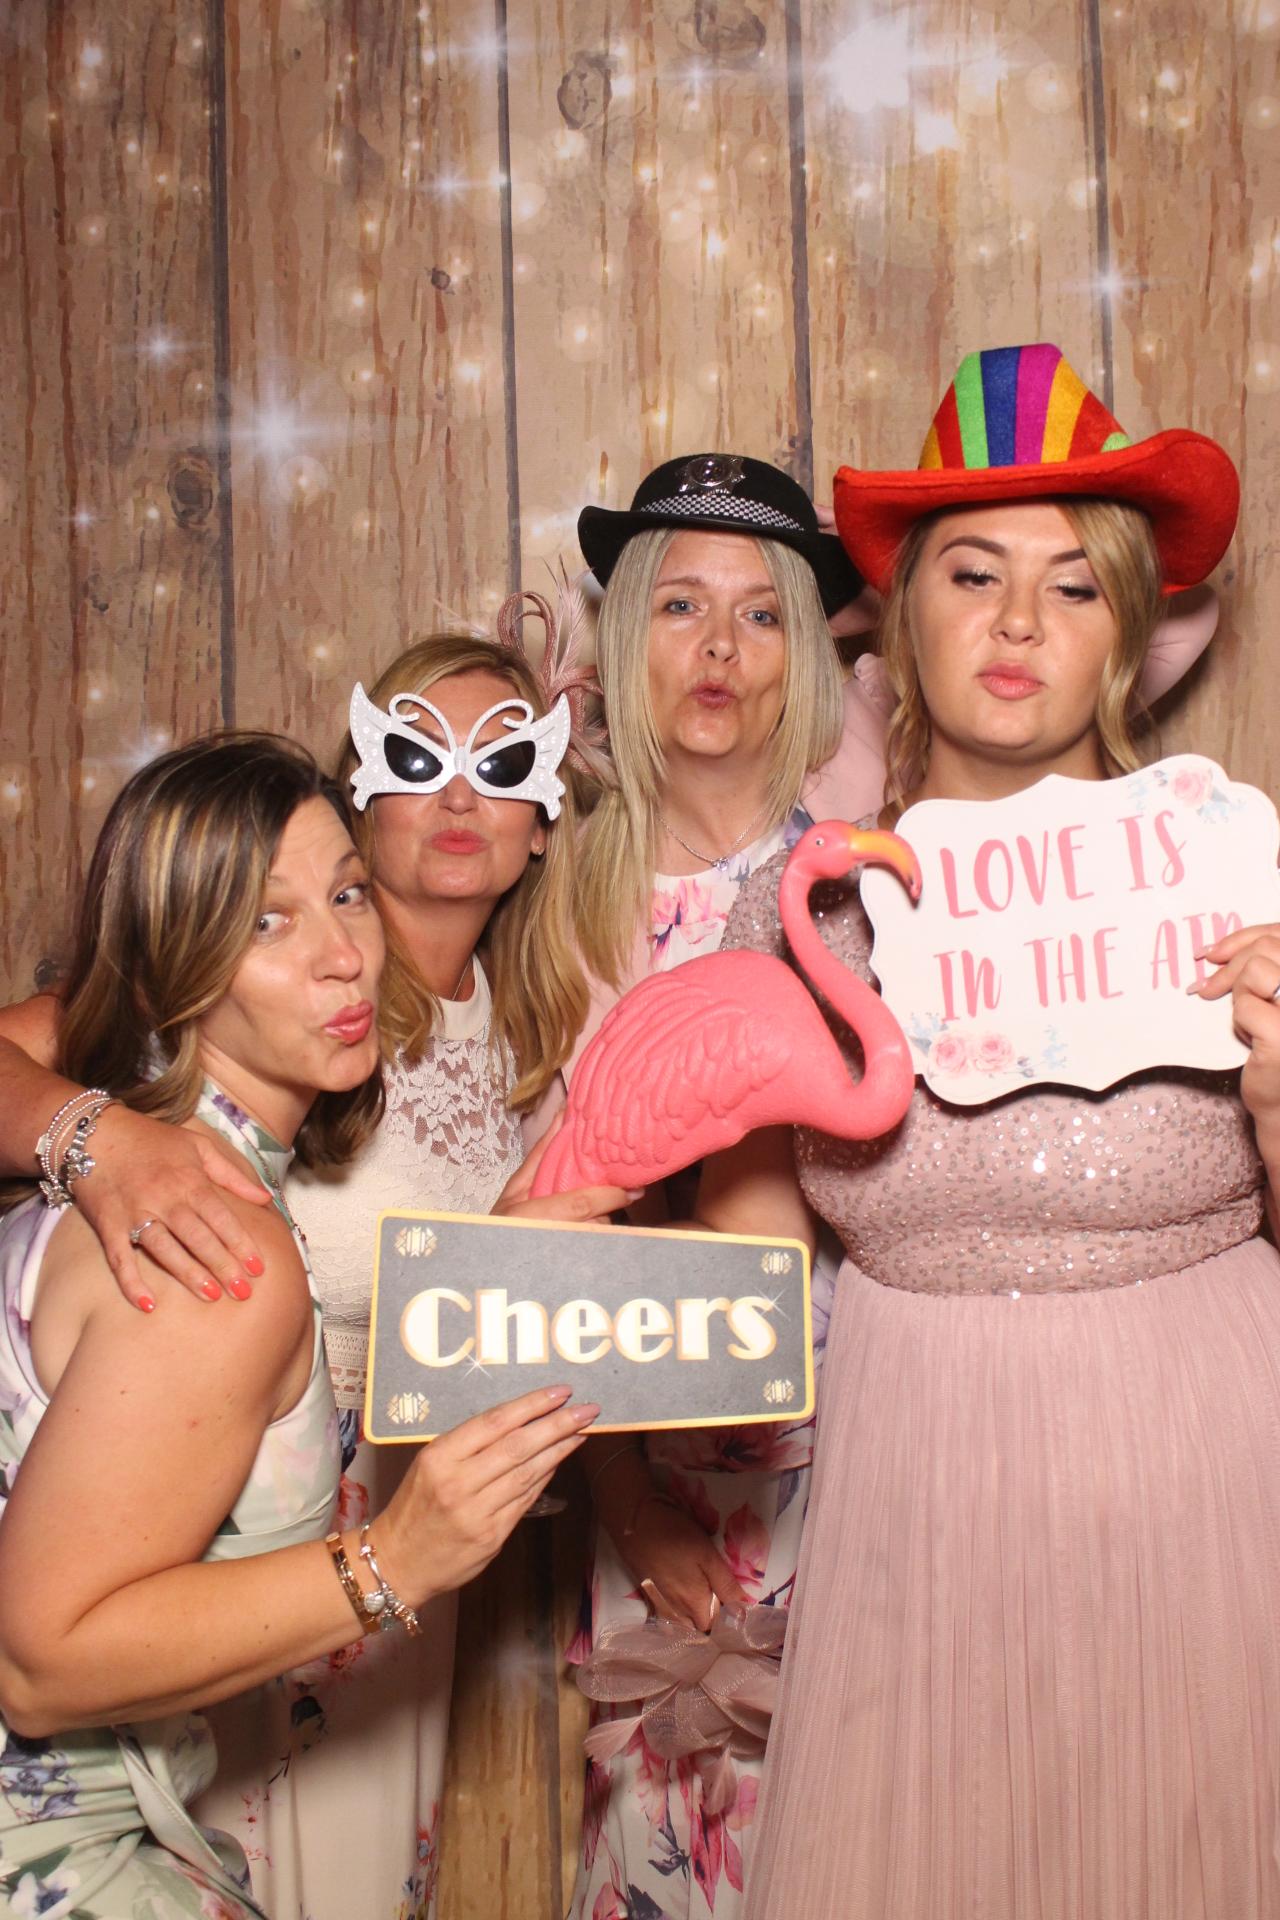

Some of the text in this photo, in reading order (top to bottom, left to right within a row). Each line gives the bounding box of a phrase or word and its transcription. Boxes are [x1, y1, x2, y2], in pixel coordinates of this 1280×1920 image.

[940, 810, 1187, 919] LOVE IS
[1024, 927, 1124, 1008] THE
[401, 1287, 778, 1368] Cheers
